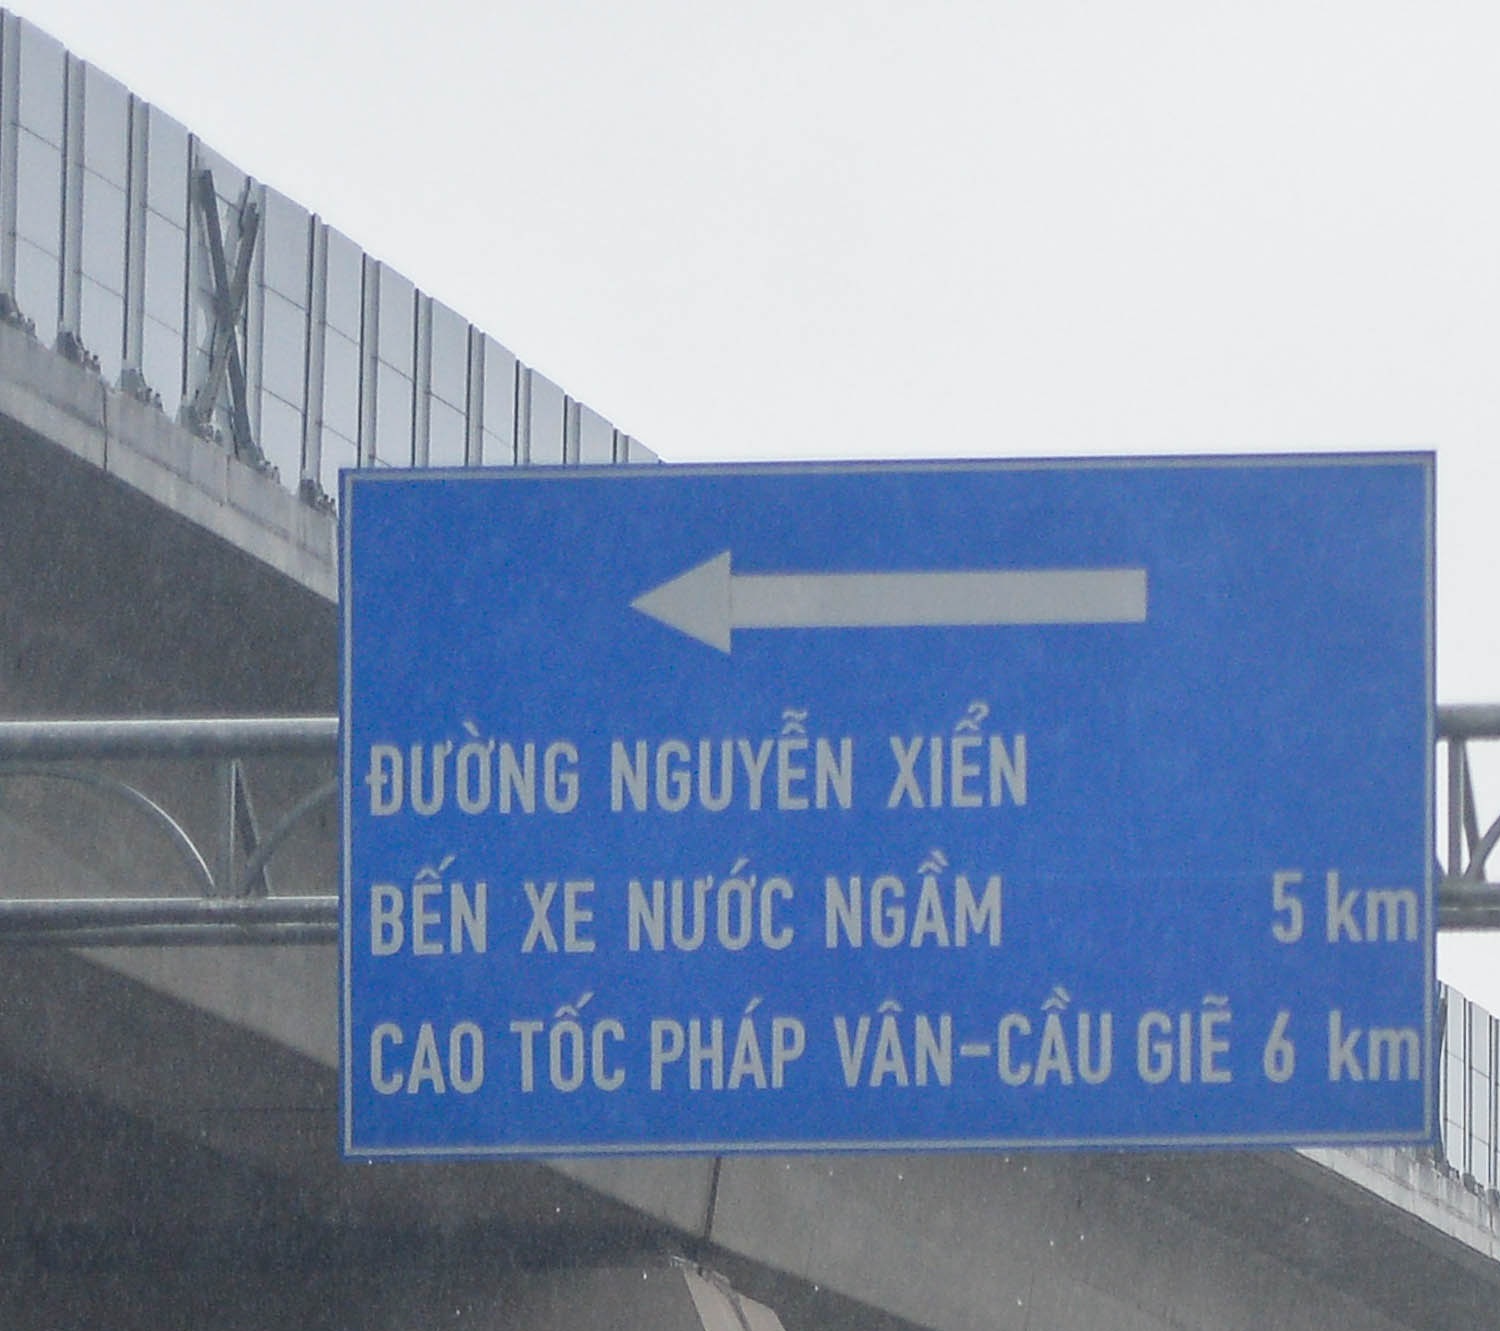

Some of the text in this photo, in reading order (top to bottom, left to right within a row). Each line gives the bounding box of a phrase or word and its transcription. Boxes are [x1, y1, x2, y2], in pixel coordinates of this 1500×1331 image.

[366, 702, 1027, 816] ĐƯỜNG NGUYỄN XIỂN
[371, 850, 1417, 955] BẾN XE NƯỚC NGẦM 5 km
[371, 1021, 484, 1094] CAO
[511, 993, 625, 1092] TỐC
[651, 998, 806, 1090] PHÁP
[1137, 995, 1231, 1083] GIẼ
[1264, 1011, 1295, 1082] 6
[1329, 1010, 1419, 1080] km
